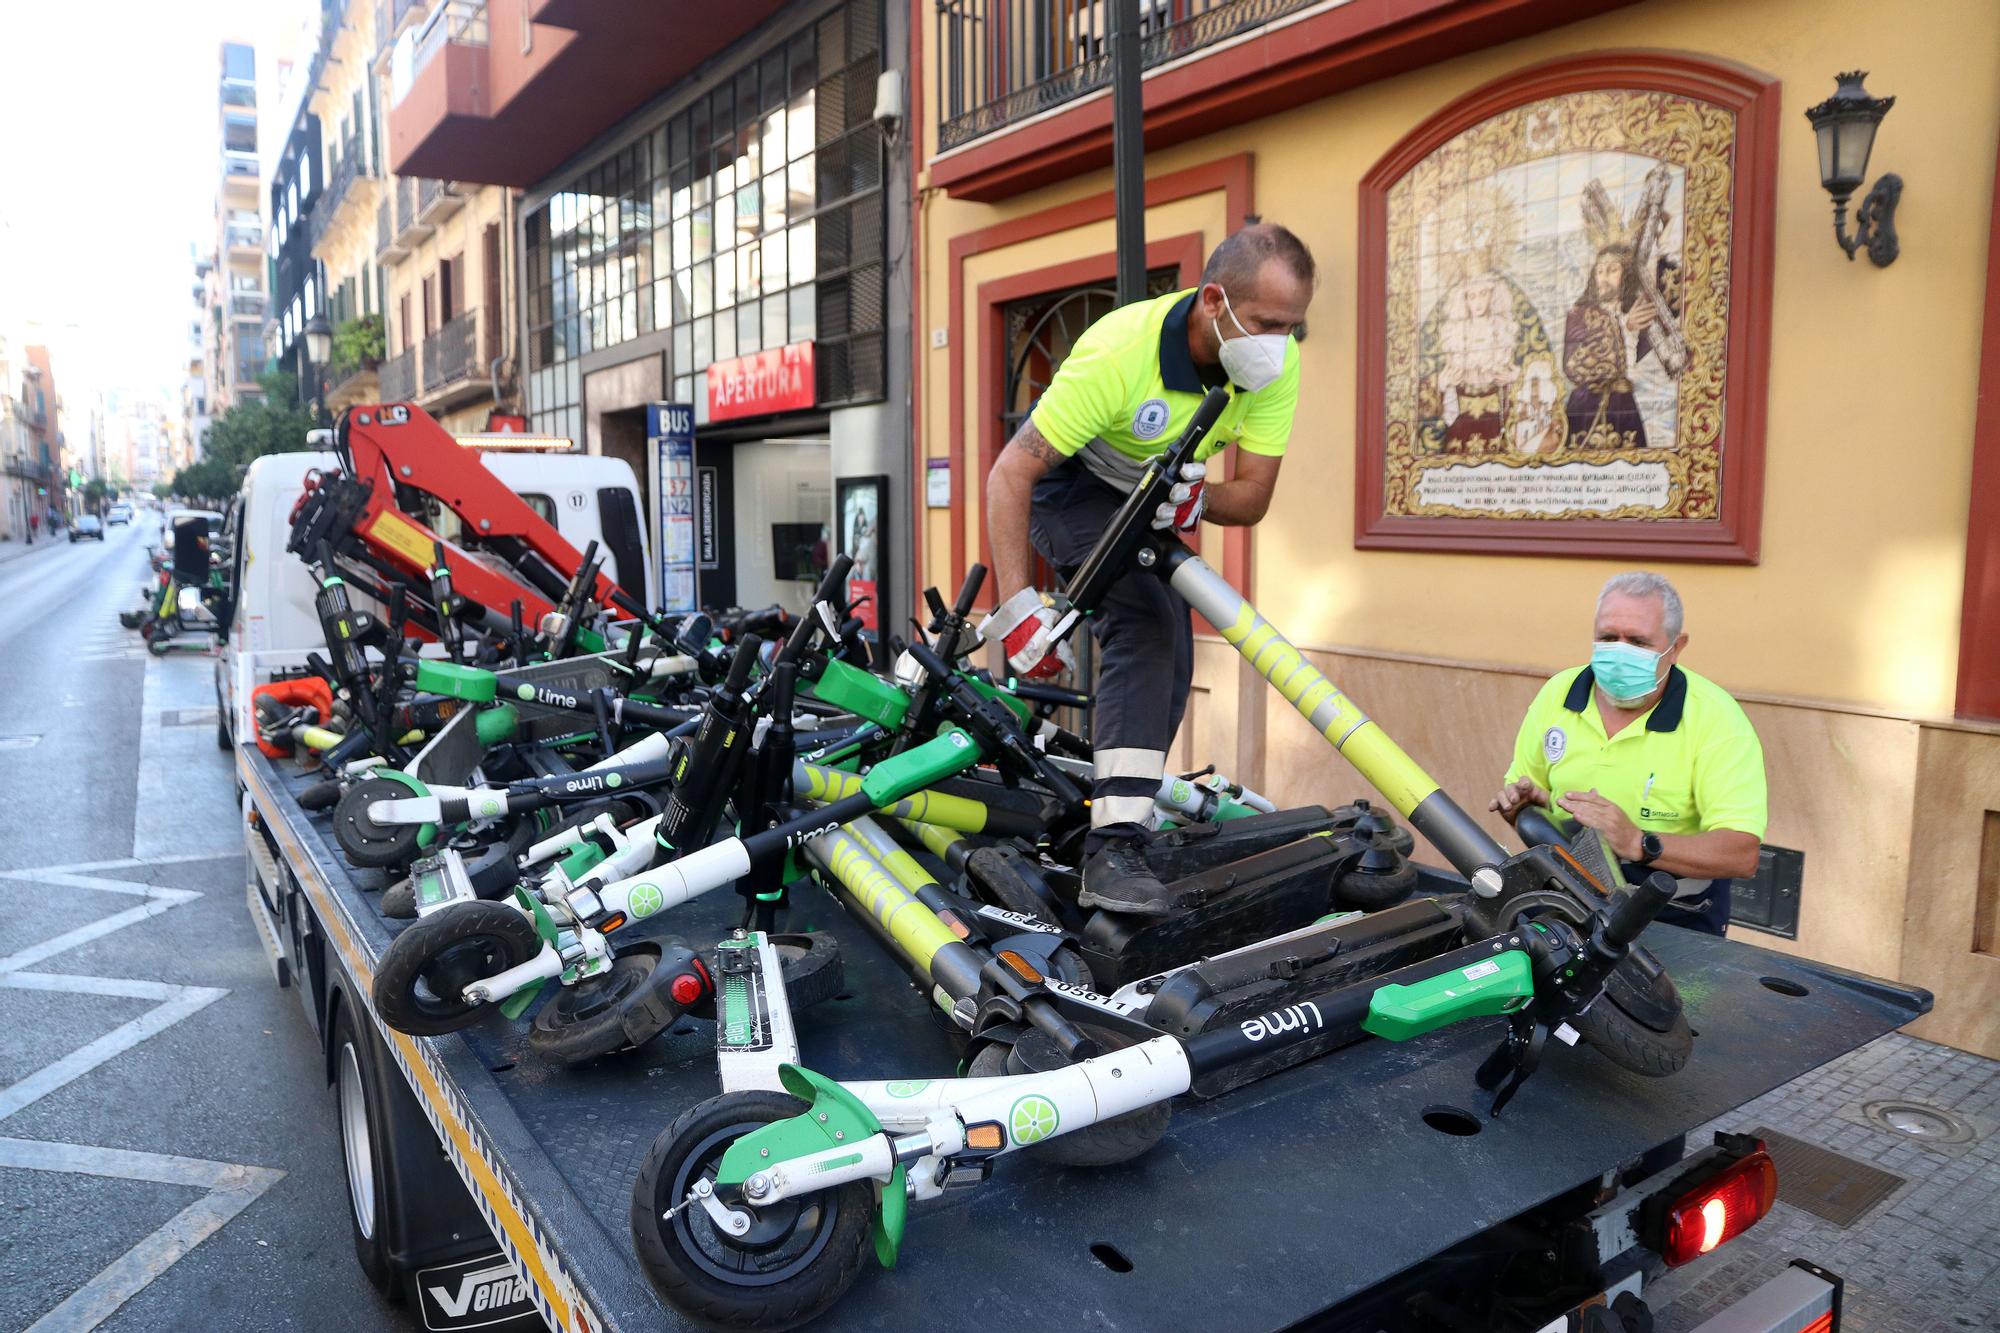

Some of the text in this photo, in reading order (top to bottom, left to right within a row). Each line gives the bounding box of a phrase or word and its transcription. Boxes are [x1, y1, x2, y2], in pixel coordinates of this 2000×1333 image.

[715, 362, 803, 408] APERTURA
[660, 409, 690, 434] BUS
[675, 461, 681, 473] 1
[670, 479, 688, 496] 37
[538, 688, 577, 709] Lime
[566, 776, 603, 792] Lime
[1057, 982, 1127, 1011] 05611
[1240, 1001, 1323, 1042] Lime
